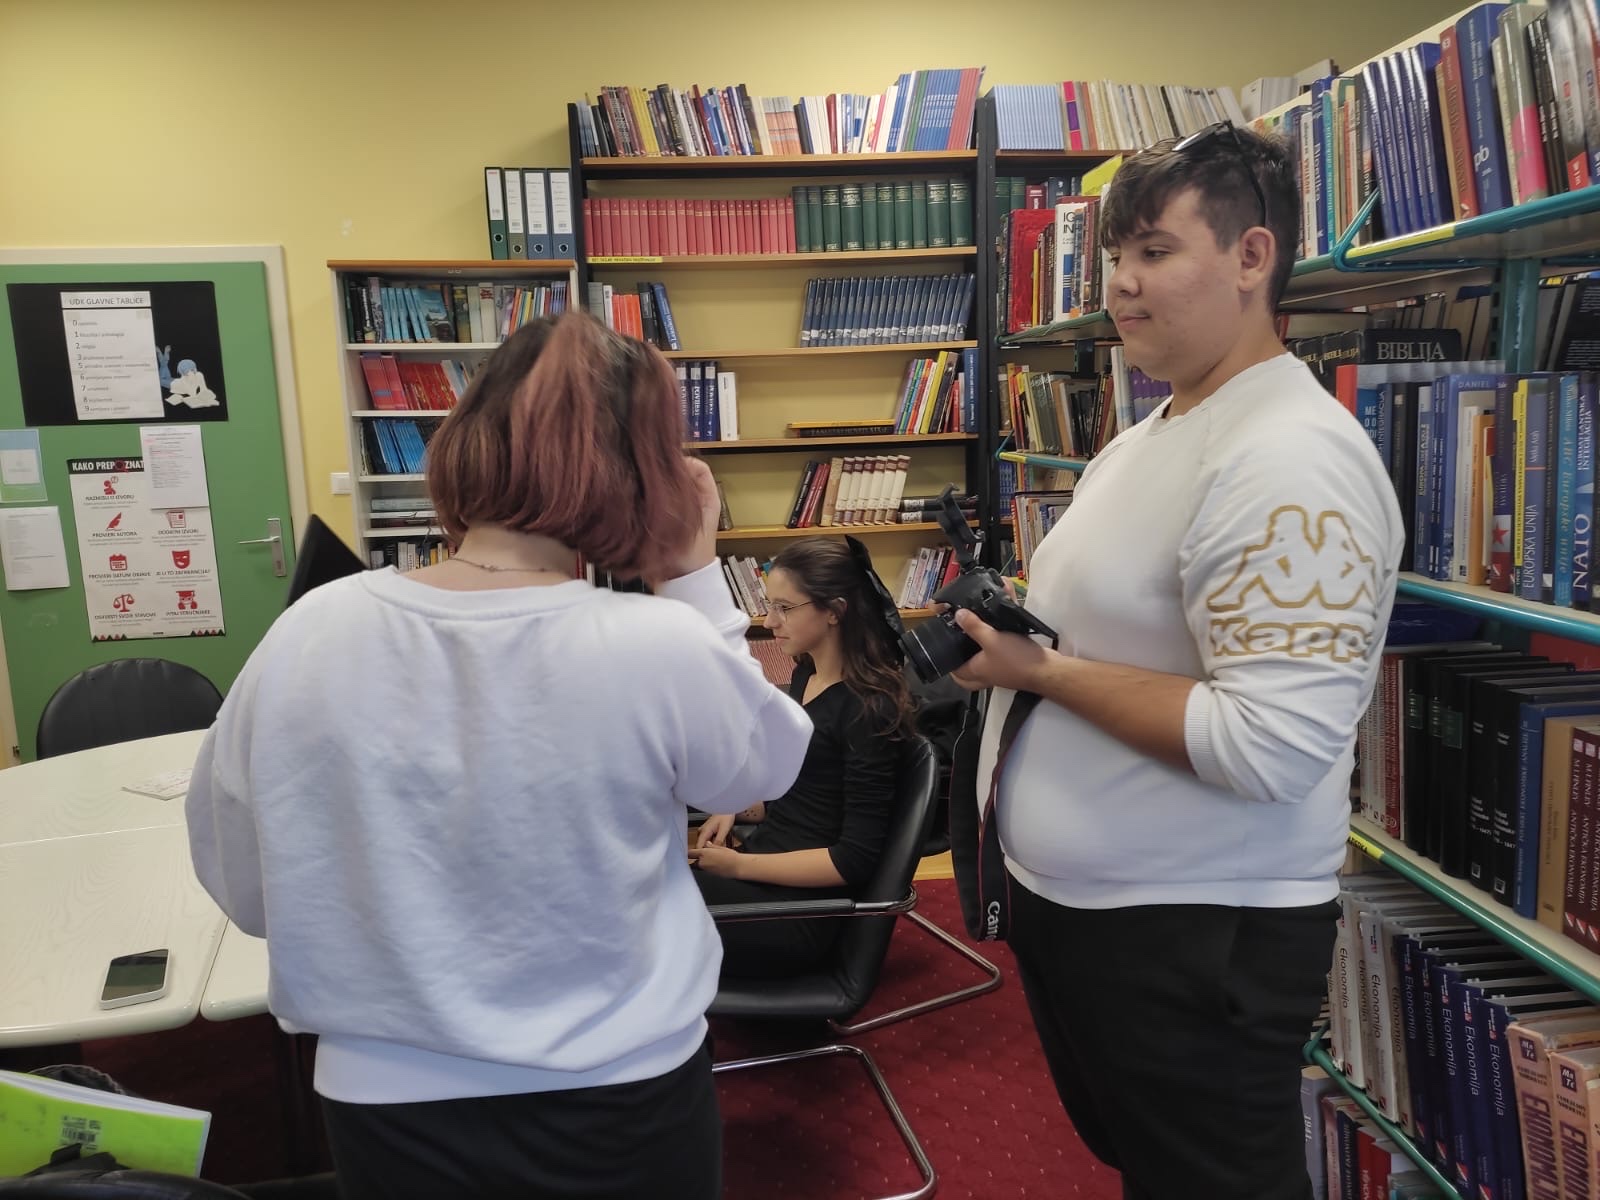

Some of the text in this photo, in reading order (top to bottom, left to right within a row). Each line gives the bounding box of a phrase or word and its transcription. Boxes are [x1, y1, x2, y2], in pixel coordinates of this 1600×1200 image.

[86, 297, 114, 305] GLAVNE
[1377, 341, 1446, 362] BIBLIJA
[1458, 380, 1490, 389] DANIEL
[72, 460, 94, 471] KAKO
[1563, 437, 1573, 467] ABC
[1583, 410, 1592, 471] INTEGRACIJA
[1560, 472, 1572, 532] Europske
[1522, 504, 1539, 588] EUROPSKA UNIJA
[1559, 538, 1569, 574] unije
[1572, 513, 1591, 591] NATO
[1210, 616, 1373, 663] Kapp
[1568, 809, 1577, 847] ANTIČKA
[1581, 814, 1590, 853] ANTIČKA
[1577, 855, 1588, 904] EKONOMIJA
[986, 900, 1001, 941] Can
[1339, 946, 1349, 1009] Ekonomija
[1371, 974, 1382, 1039] Ekonomija
[1405, 974, 1417, 1040] Ekonomija
[1423, 990, 1436, 1057] Ekonomija
[1442, 1007, 1457, 1077] Ekonomija
[1464, 1024, 1481, 1097] Ekonomija
[1489, 1042, 1505, 1117] Ekonomija
